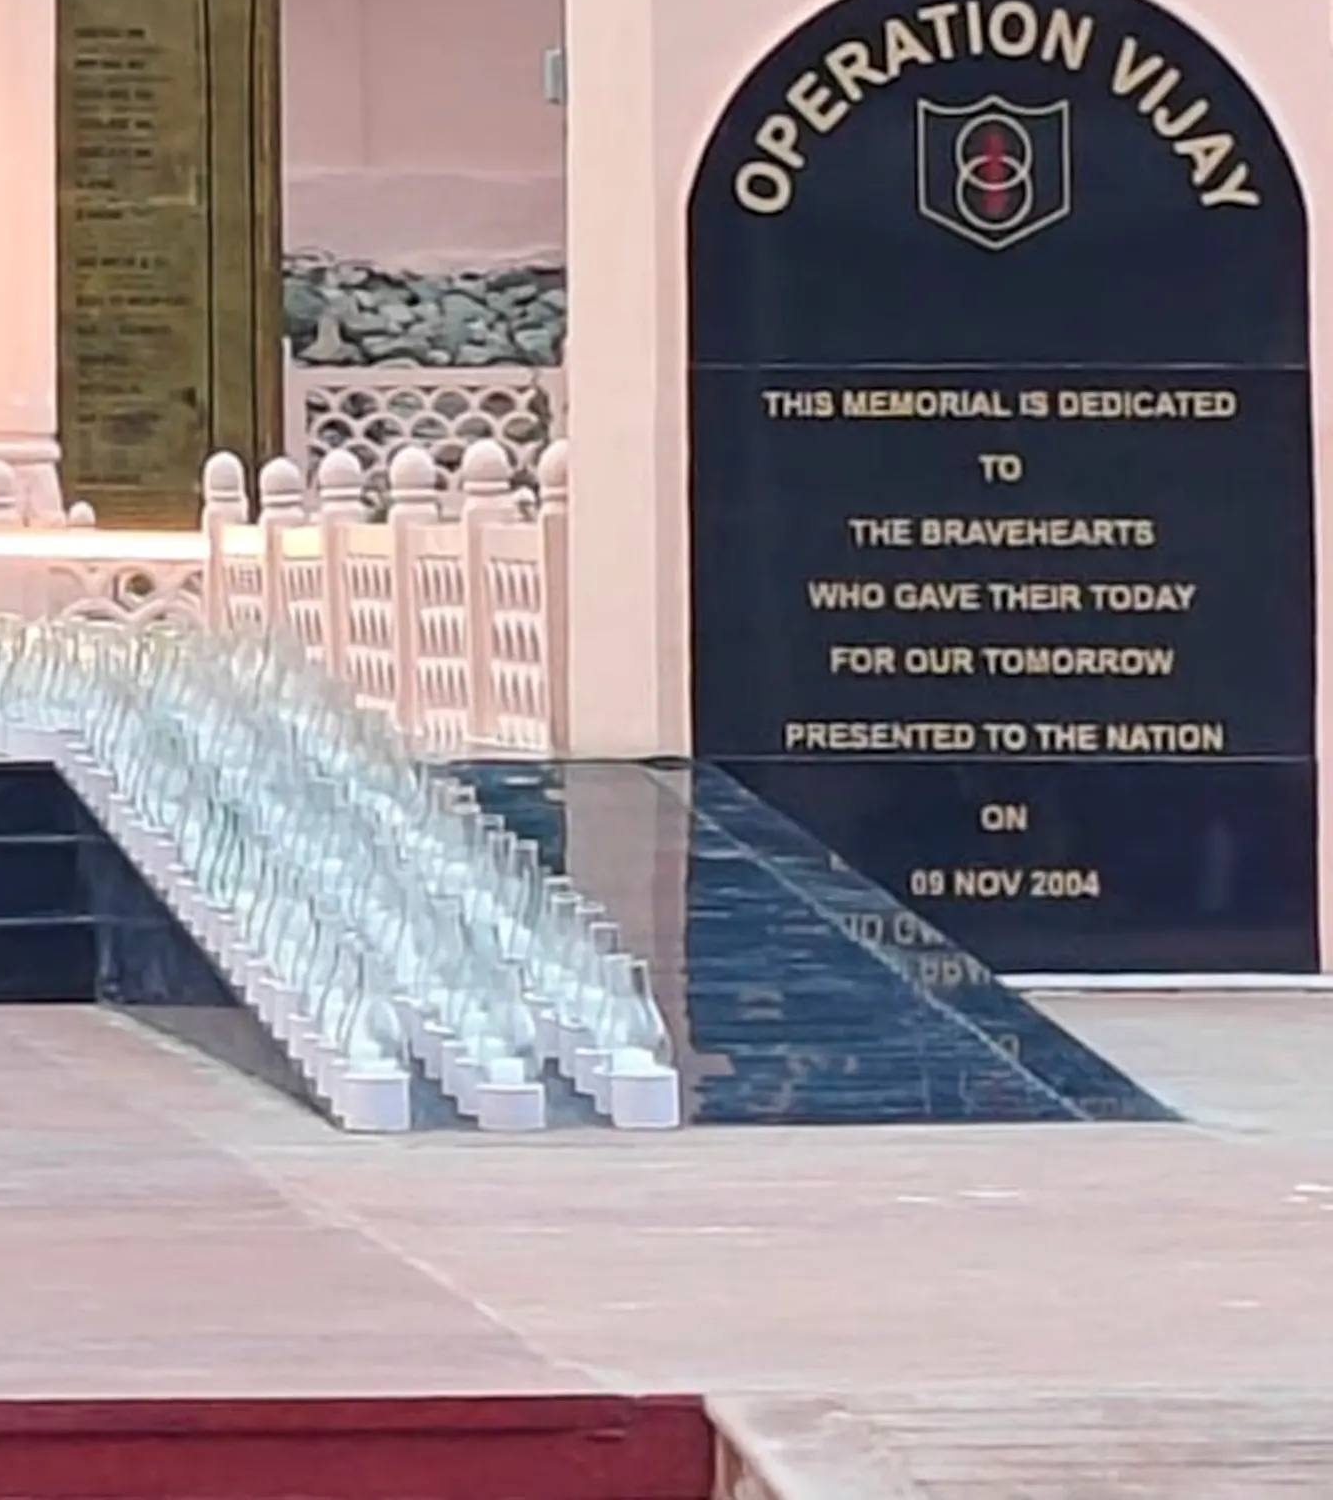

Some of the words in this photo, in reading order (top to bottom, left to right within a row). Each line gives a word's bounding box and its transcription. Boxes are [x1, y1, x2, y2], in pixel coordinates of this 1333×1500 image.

[735, 0, 1093, 213] OPERATION
[1111, 36, 1260, 206] VIJAY
[763, 391, 834, 417] THIS
[843, 390, 1012, 417] MEMORIAL
[1019, 391, 1049, 417] IS
[1058, 391, 1236, 417] DEDICATED
[979, 455, 1022, 481] TO
[849, 518, 912, 545] THE
[921, 519, 1154, 546] BRAVEHEARTS
[809, 583, 885, 609] WHO
[894, 583, 981, 610] GAVE
[988, 583, 1082, 610] THEIR
[1089, 584, 1196, 610] TODAY
[830, 647, 895, 673] FOR
[905, 647, 974, 673] OUR
[982, 648, 1174, 675] TOMORROW
[786, 723, 975, 750] PRESENTED
[983, 723, 1027, 750] TO
[1034, 723, 1098, 751] THE
[1106, 724, 1223, 751] NATION
[981, 805, 1027, 830] ON
[911, 870, 944, 895] 09
[954, 871, 1022, 896] NOV
[1031, 870, 1100, 896] 2004
